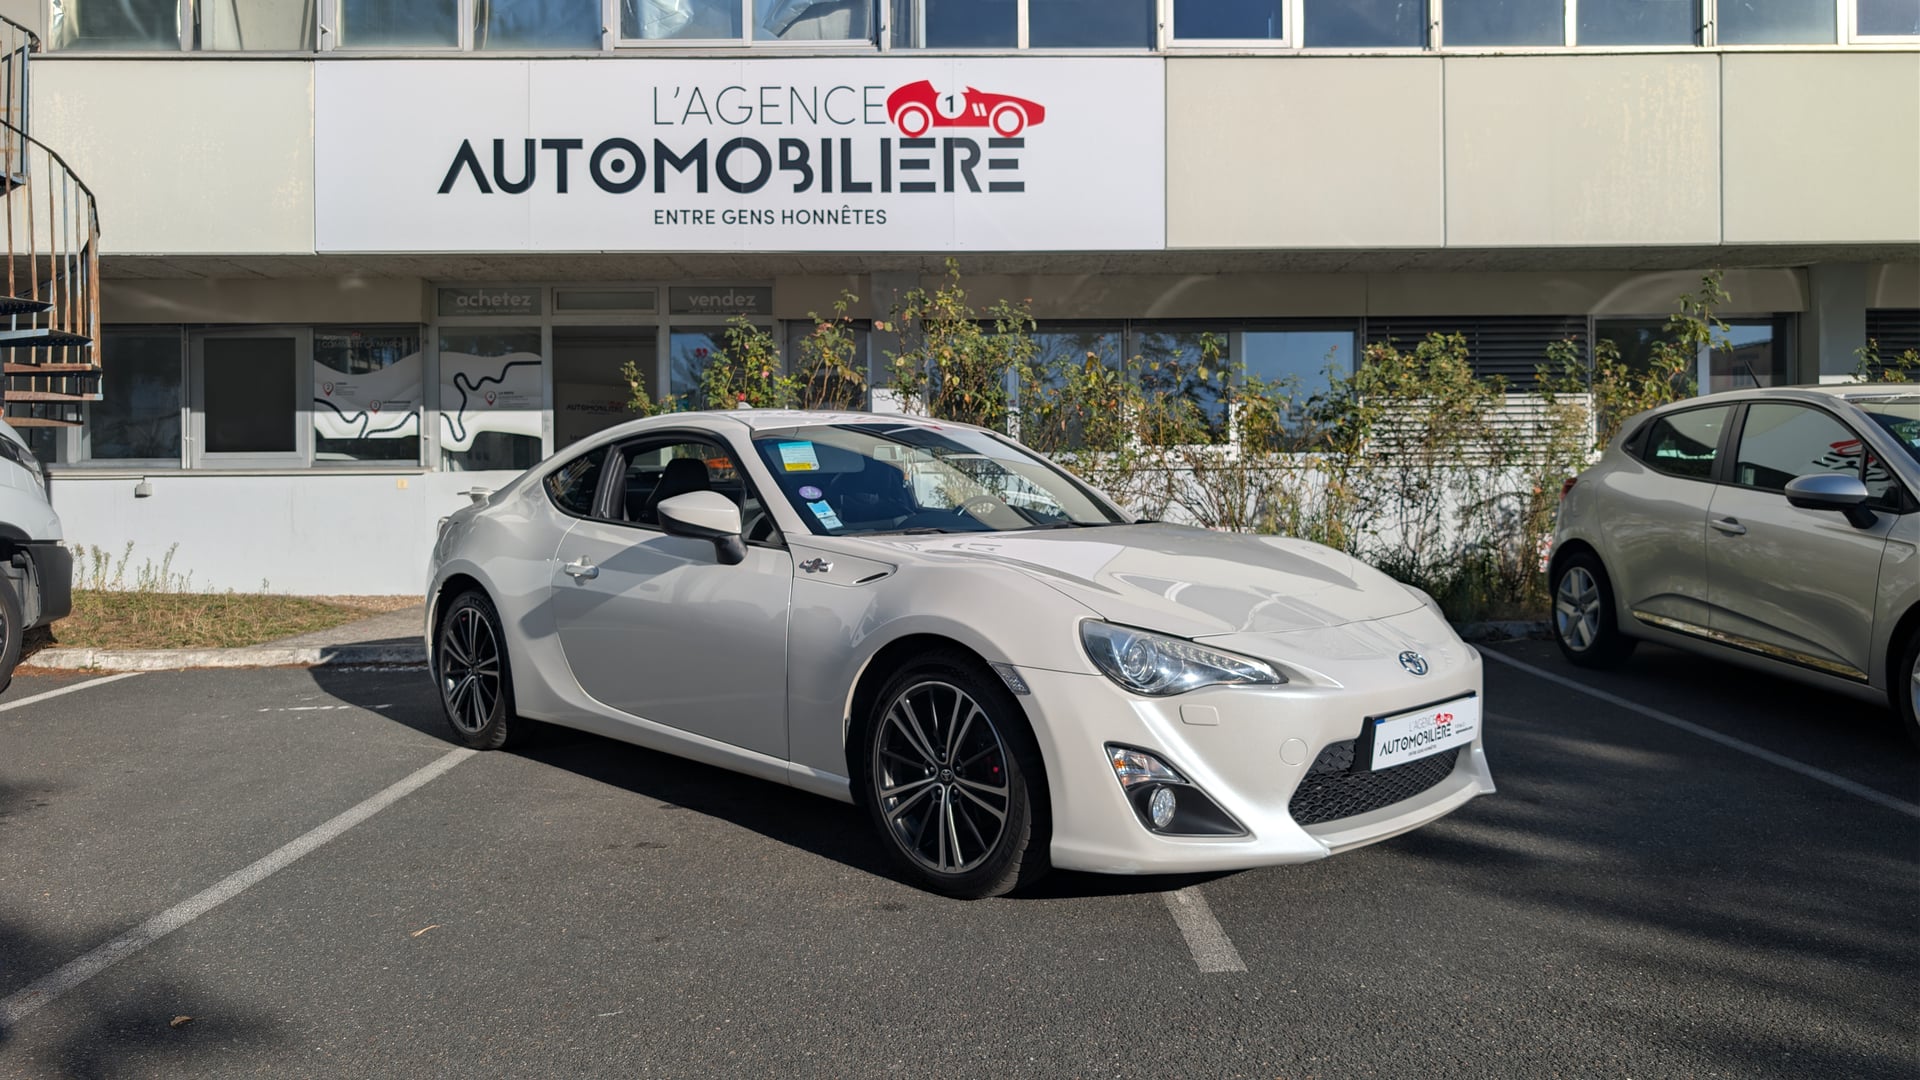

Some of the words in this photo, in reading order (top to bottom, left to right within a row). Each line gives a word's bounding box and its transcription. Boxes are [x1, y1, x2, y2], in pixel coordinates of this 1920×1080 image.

[653, 85, 886, 125] L'AGENCE
[945, 95, 954, 113] 1
[437, 138, 1025, 194] AUTOMOBILIERE
[654, 208, 716, 225] ENTRE
[721, 208, 775, 225] GENS
[781, 204, 887, 225] HONNÊTES
[456, 289, 532, 306] achetez
[688, 288, 756, 306] vendez
[1379, 723, 1452, 757] AUTOMOBILIERE
